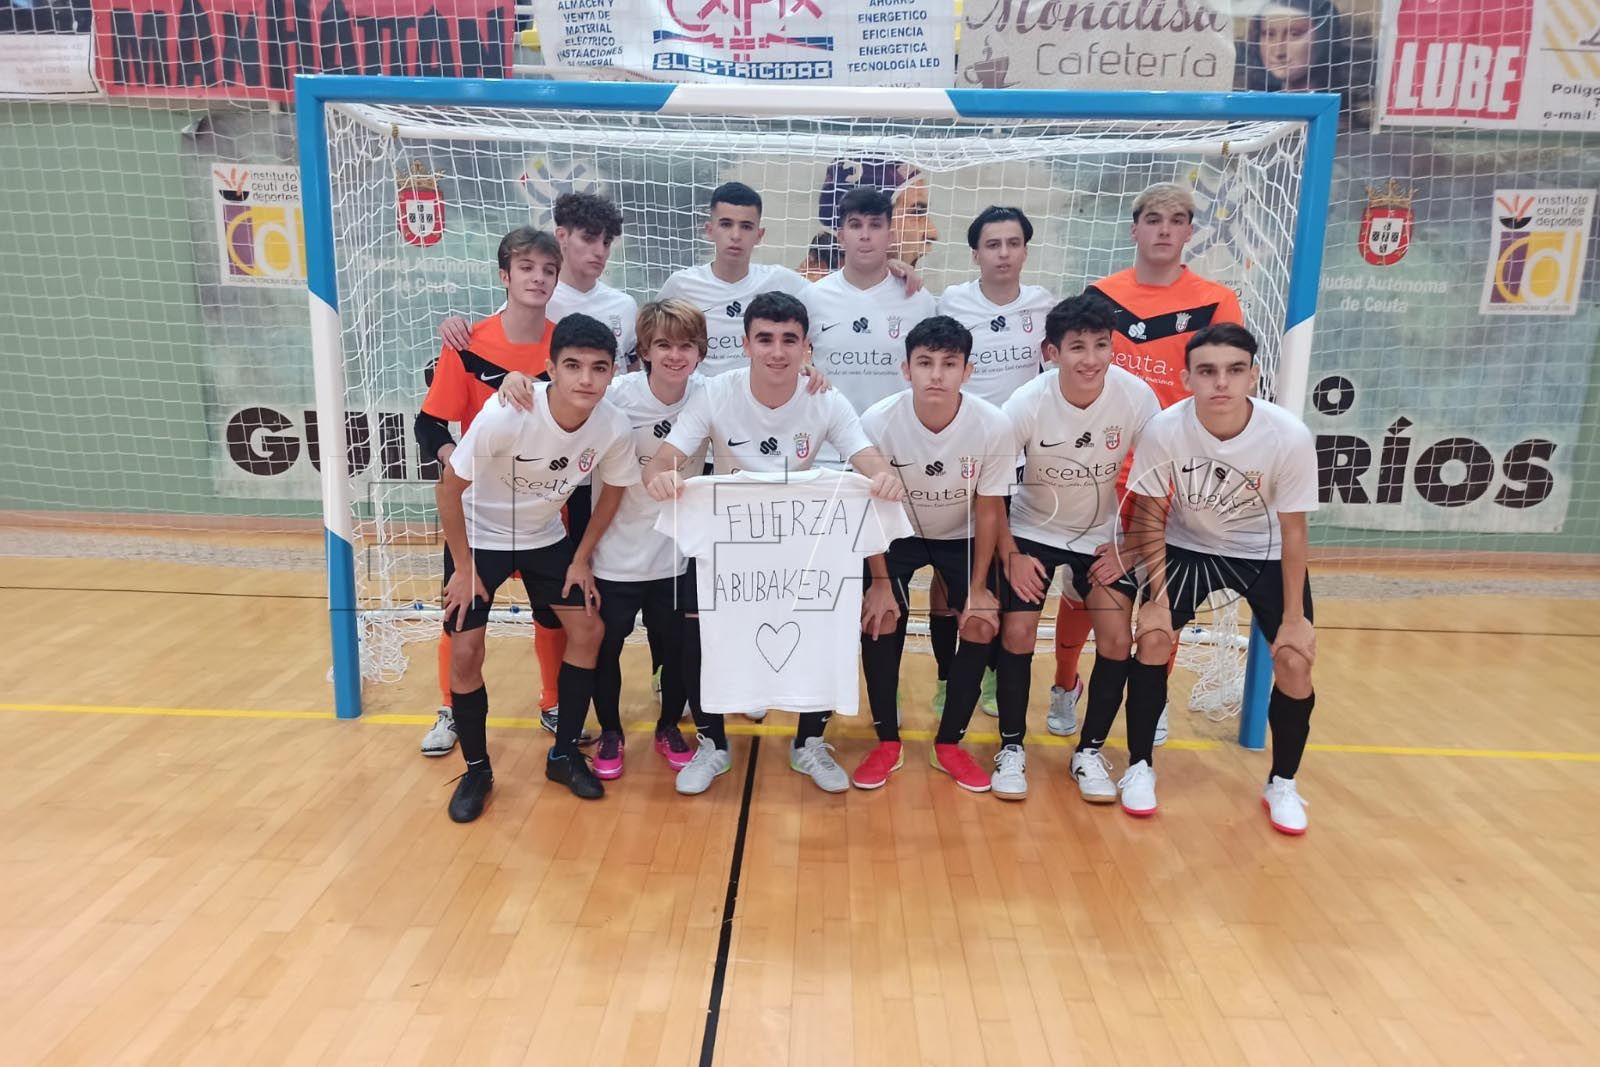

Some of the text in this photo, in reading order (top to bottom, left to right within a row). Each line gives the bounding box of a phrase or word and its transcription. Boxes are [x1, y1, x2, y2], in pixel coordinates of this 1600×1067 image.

[563, 10, 610, 23] VENTA DE
[858, 10, 927, 23] ENERGETICO
[565, 23, 612, 35] MATERIAL
[862, 26, 923, 40] EFICIENCIA
[111, 0, 503, 88] MANHATTAN
[860, 42, 927, 56] ENERGETICA
[848, 58, 940, 72] TECNOLOGÍA LED
[1036, 42, 1217, 77] Cafetería
[1395, 42, 1520, 112] LUBE
[282, 181, 298, 192] de
[1319, 273, 1362, 290] iudad
[1341, 296, 1409, 313] de Ceuta
[727, 499, 848, 541] FUERZA
[714, 568, 832, 602] ABUBAKER
